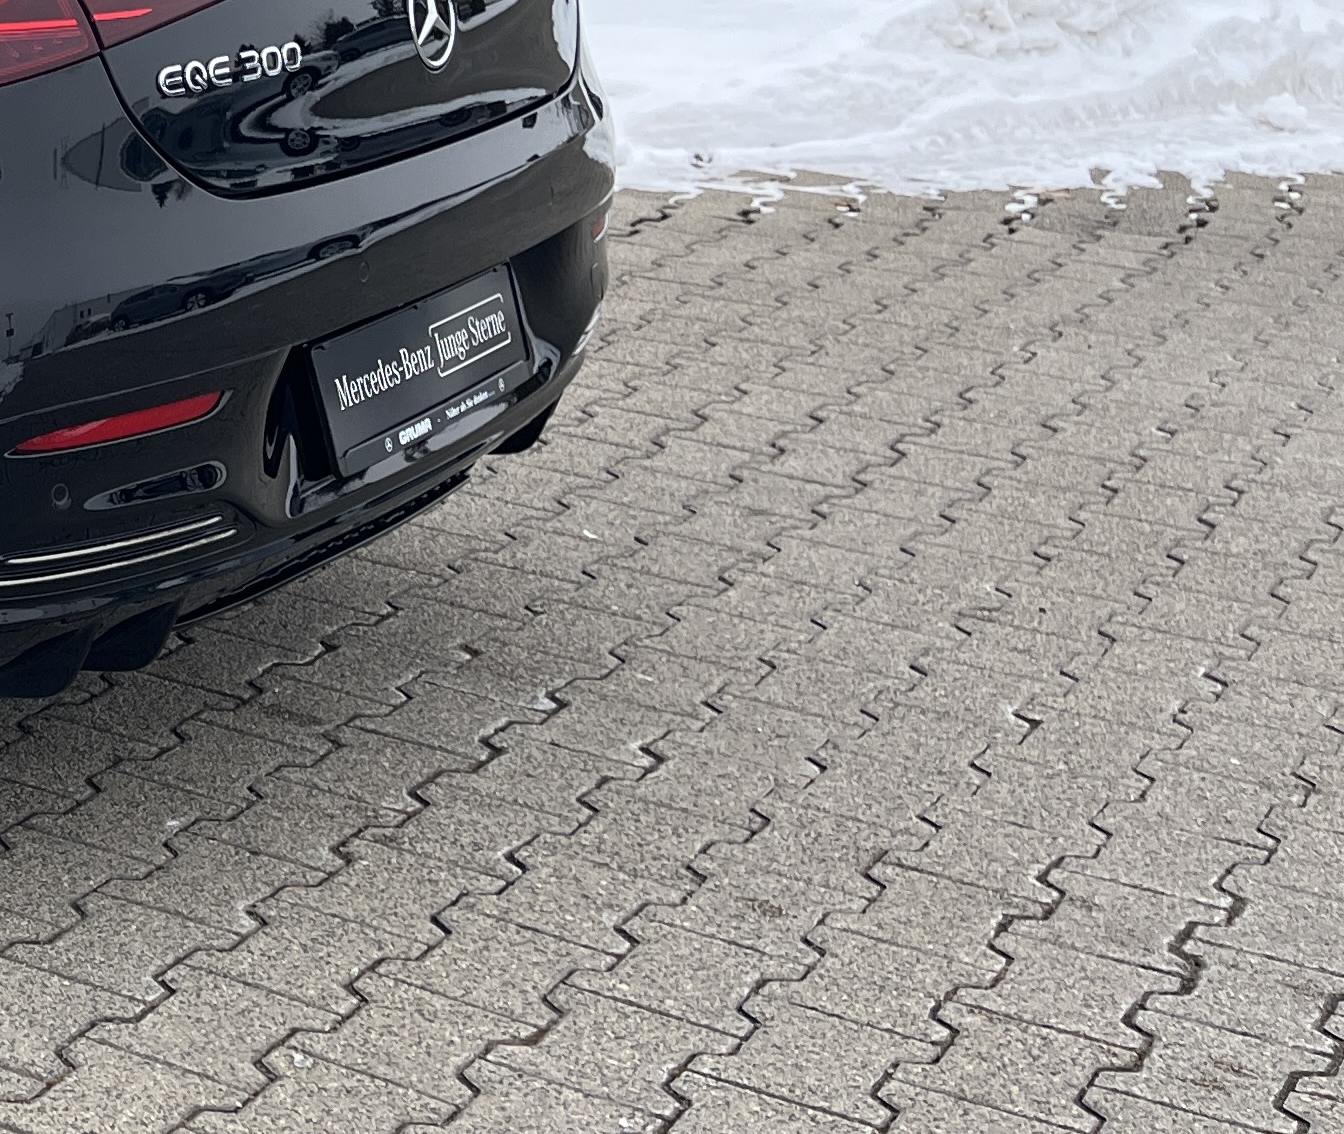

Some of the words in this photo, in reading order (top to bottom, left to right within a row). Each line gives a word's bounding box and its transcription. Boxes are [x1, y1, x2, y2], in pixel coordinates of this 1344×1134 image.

[157, 55, 233, 97] EQE
[239, 41, 303, 82] 300
[334, 343, 435, 411] Mercedes-Benz
[434, 331, 471, 368] Junge
[467, 310, 507, 347] Sterne
[398, 417, 433, 446] GRUMA
